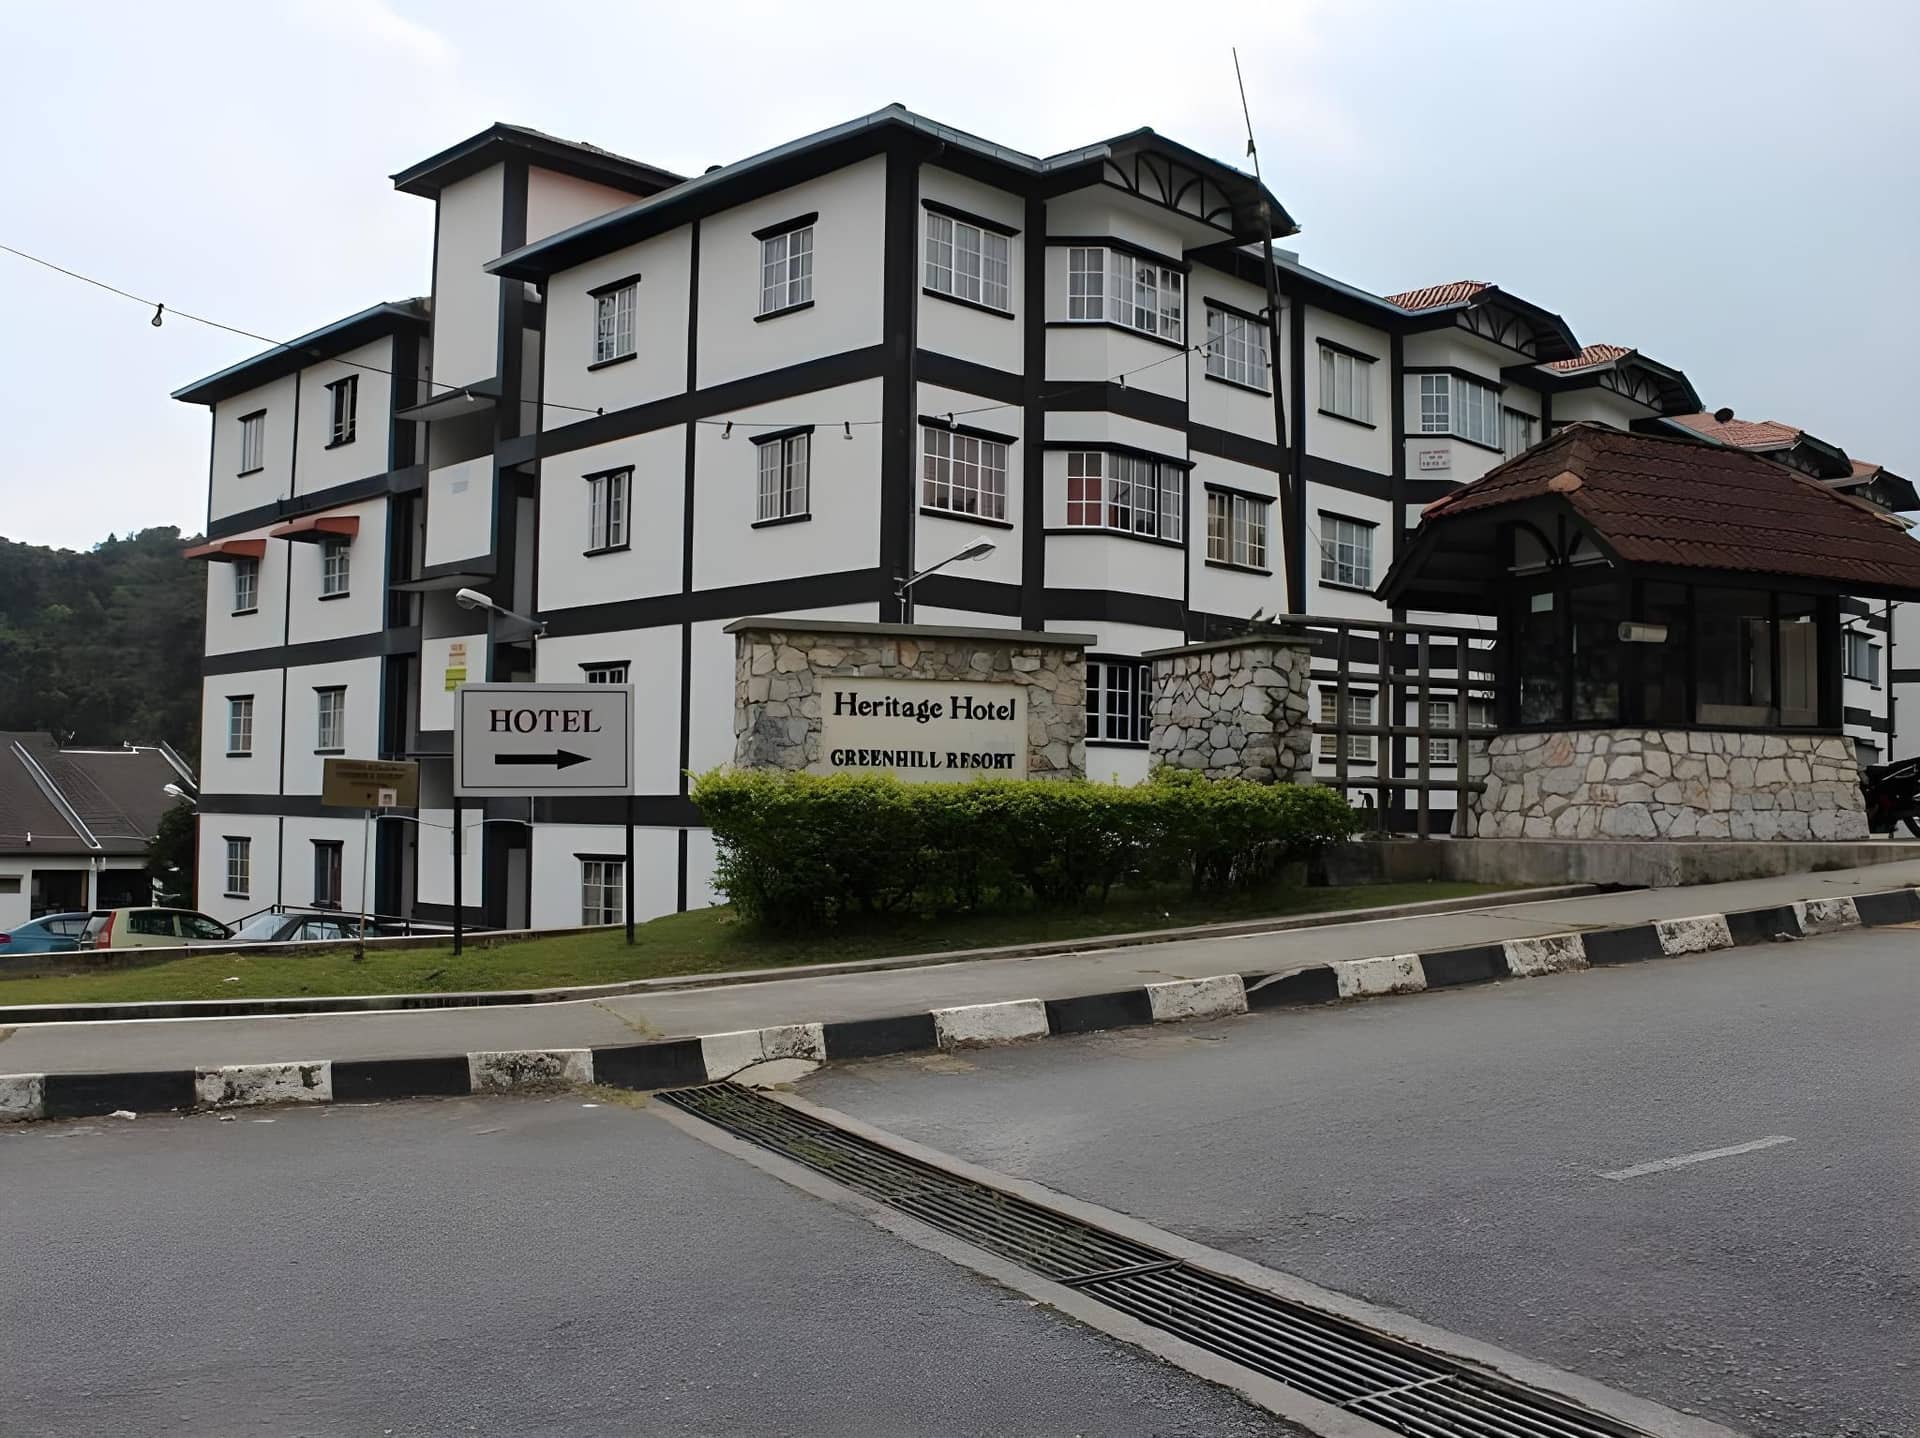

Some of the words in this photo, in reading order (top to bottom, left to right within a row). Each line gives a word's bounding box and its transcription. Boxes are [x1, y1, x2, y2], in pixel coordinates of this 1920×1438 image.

[832, 691, 943, 724] Heritage
[949, 695, 1016, 721] Hotel
[489, 709, 603, 734] HOTEL
[830, 748, 943, 769] GREENHILL
[945, 751, 1016, 770] RESORT
